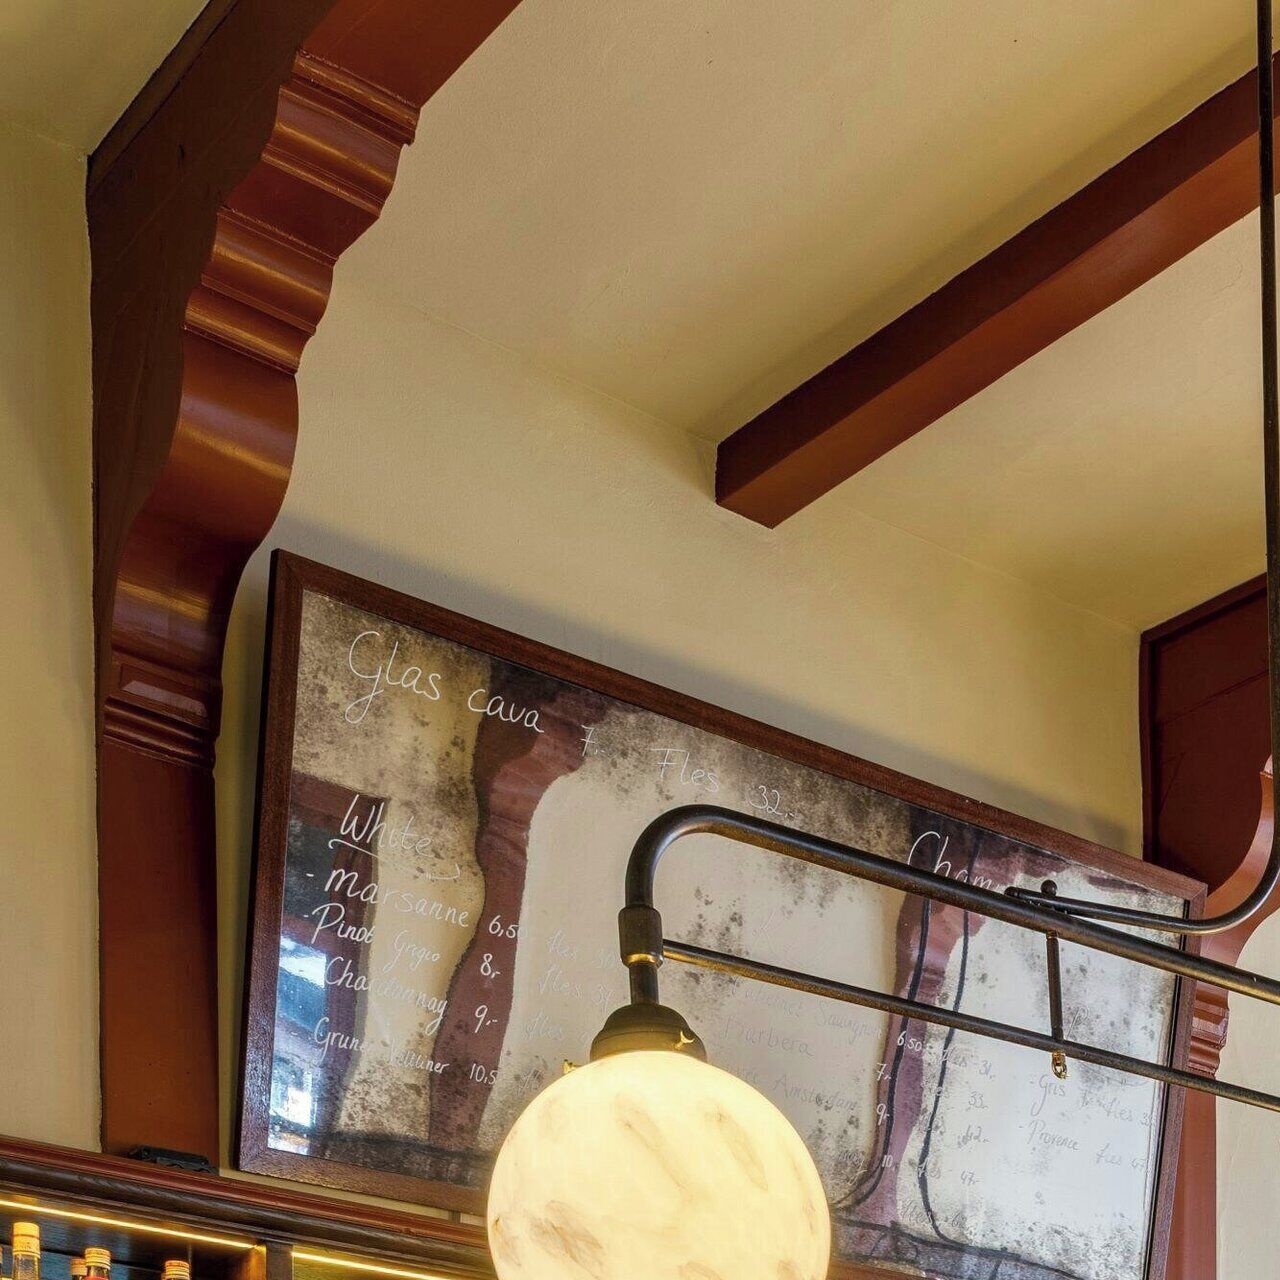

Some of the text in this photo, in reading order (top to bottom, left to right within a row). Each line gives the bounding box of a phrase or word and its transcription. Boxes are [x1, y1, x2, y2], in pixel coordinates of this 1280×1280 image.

[344, 630, 442, 724] Glas
[467, 688, 545, 734] cava
[651, 747, 721, 794] Fles
[338, 794, 436, 858] White
[906, 830, 1001, 890] Cham
[311, 902, 376, 945] Pinot
